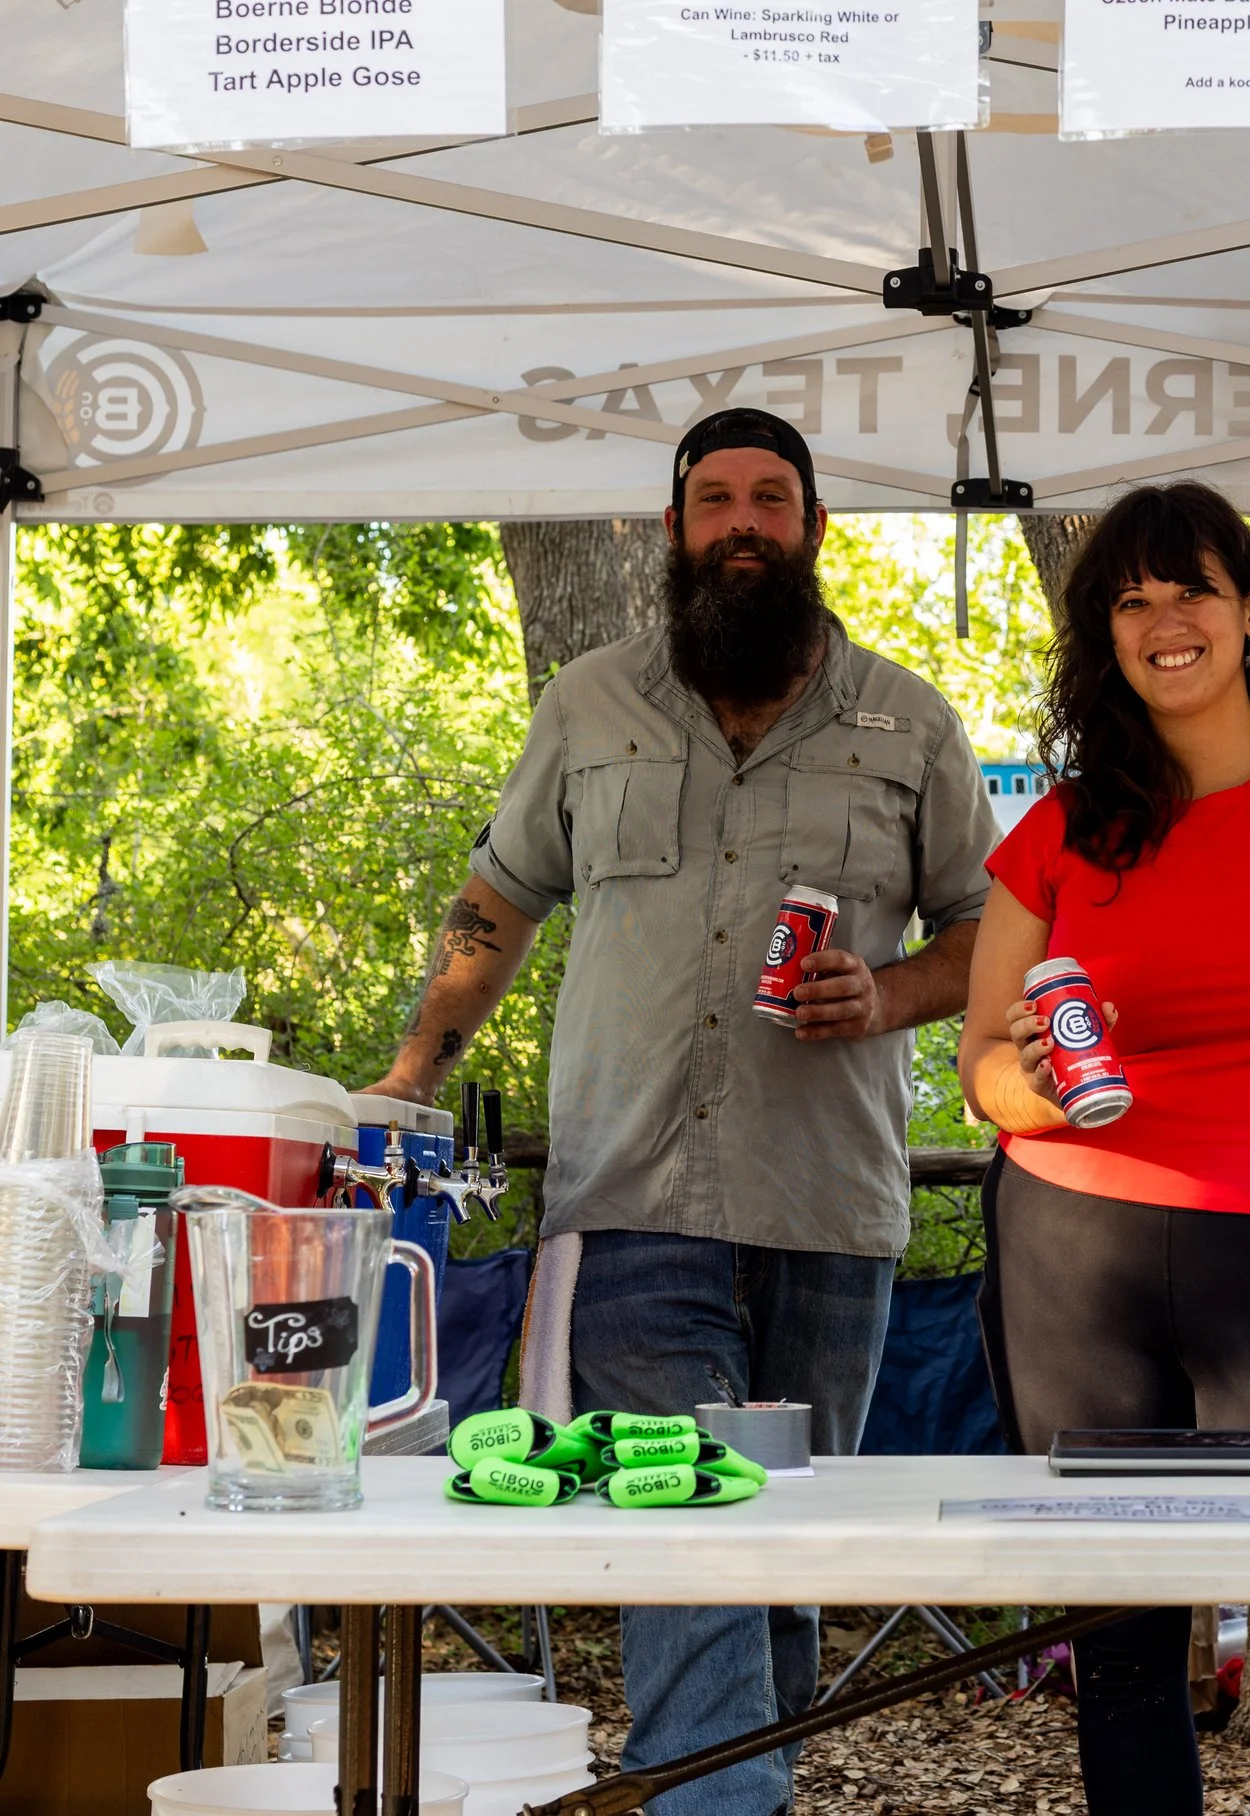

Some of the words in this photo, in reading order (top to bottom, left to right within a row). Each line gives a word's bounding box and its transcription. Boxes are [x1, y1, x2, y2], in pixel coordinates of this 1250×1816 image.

[215, 0, 309, 19] Boerne
[319, 0, 412, 15] Blonde
[680, 8, 710, 21] Can
[714, 8, 757, 21] Wine:
[761, 9, 832, 26] Sparkling
[837, 10, 880, 23] White
[884, 13, 900, 23] or
[216, 30, 361, 55] Borderside
[371, 29, 414, 50] IPA
[731, 28, 815, 42] Lambrusco
[819, 30, 849, 43] Red
[752, 48, 800, 62] $11.50
[818, 51, 841, 63] tax
[208, 70, 257, 92] Tart
[265, 66, 342, 94] Apple
[352, 66, 421, 87] Gose
[1185, 76, 1213, 89] Add
[1217, 79, 1225, 88] a
[248, 1311, 324, 1364] Tips
[628, 1423, 683, 1436] CIBOLO
[470, 1429, 522, 1451] CIBOLO
[632, 1441, 686, 1457] CIBOLO
[489, 1470, 545, 1493] CIBOLO
[625, 1475, 681, 1496] CIBOLO
